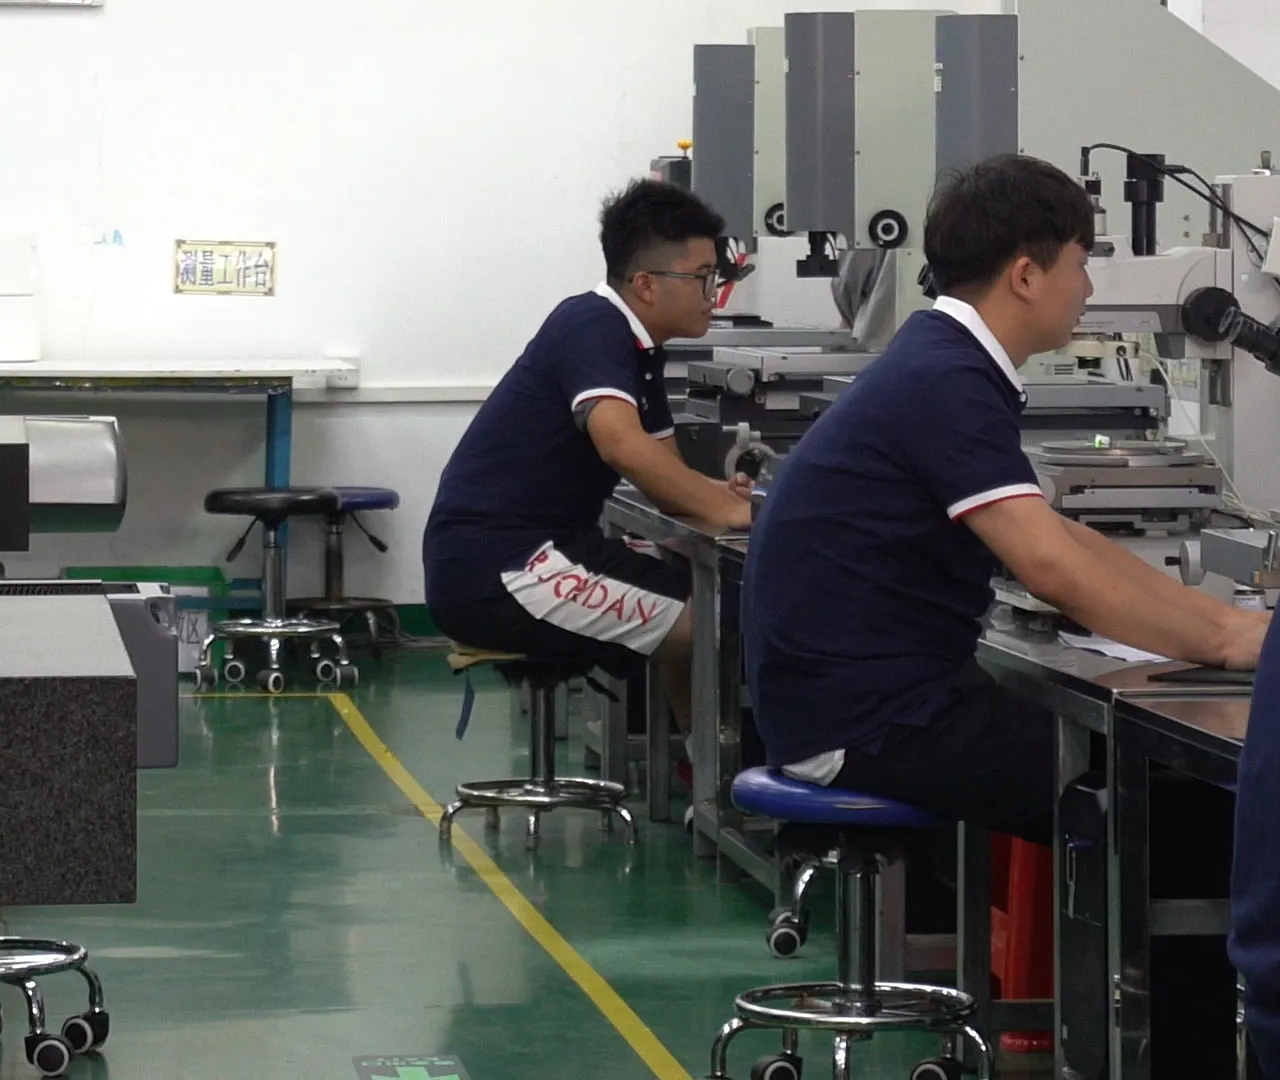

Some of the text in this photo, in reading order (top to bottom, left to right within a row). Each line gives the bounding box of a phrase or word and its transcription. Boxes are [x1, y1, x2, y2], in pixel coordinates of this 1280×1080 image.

[181, 249, 268, 287] 测量工作台
